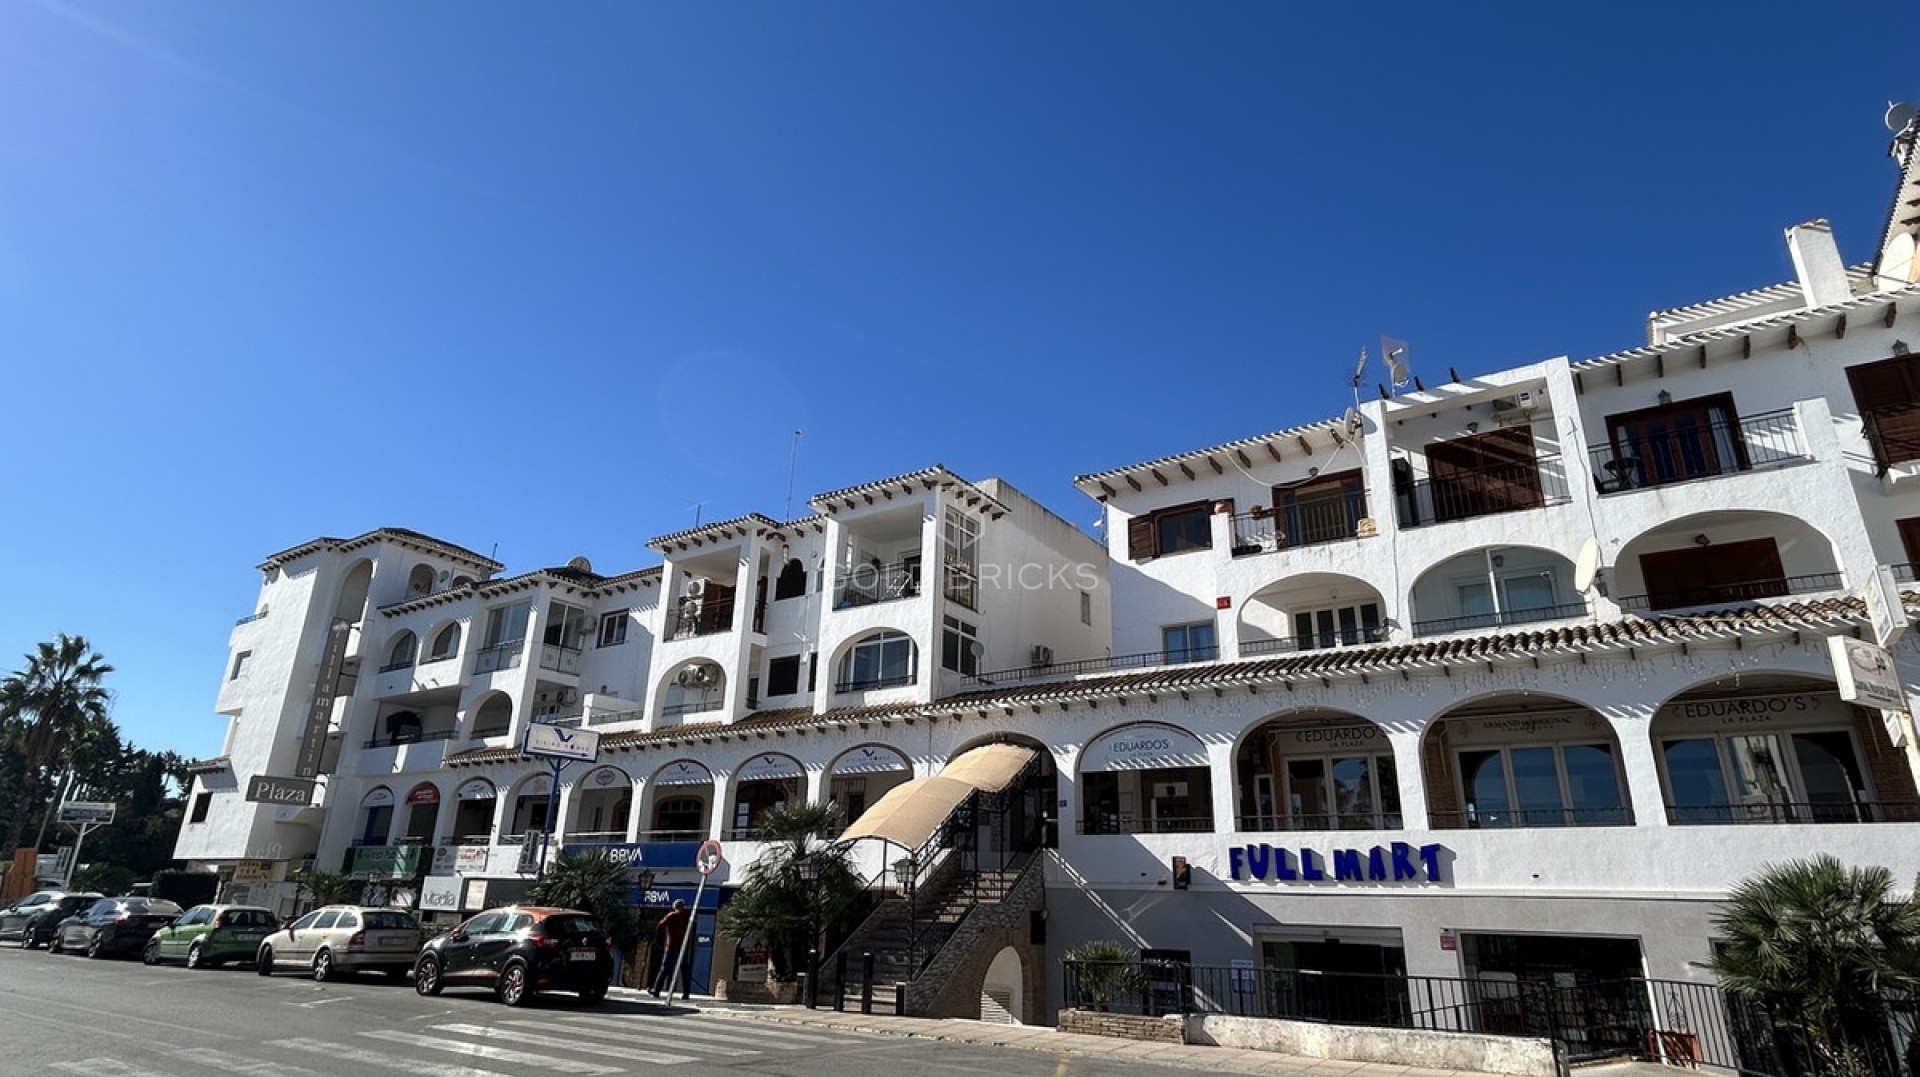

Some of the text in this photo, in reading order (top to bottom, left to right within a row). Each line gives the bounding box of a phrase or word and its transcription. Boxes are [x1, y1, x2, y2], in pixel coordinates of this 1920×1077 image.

[1685, 695, 1806, 718] EDUARDO'S
[254, 781, 306, 801] Plaza
[609, 847, 643, 863] BBVA
[1228, 841, 1441, 882] FULL MART
